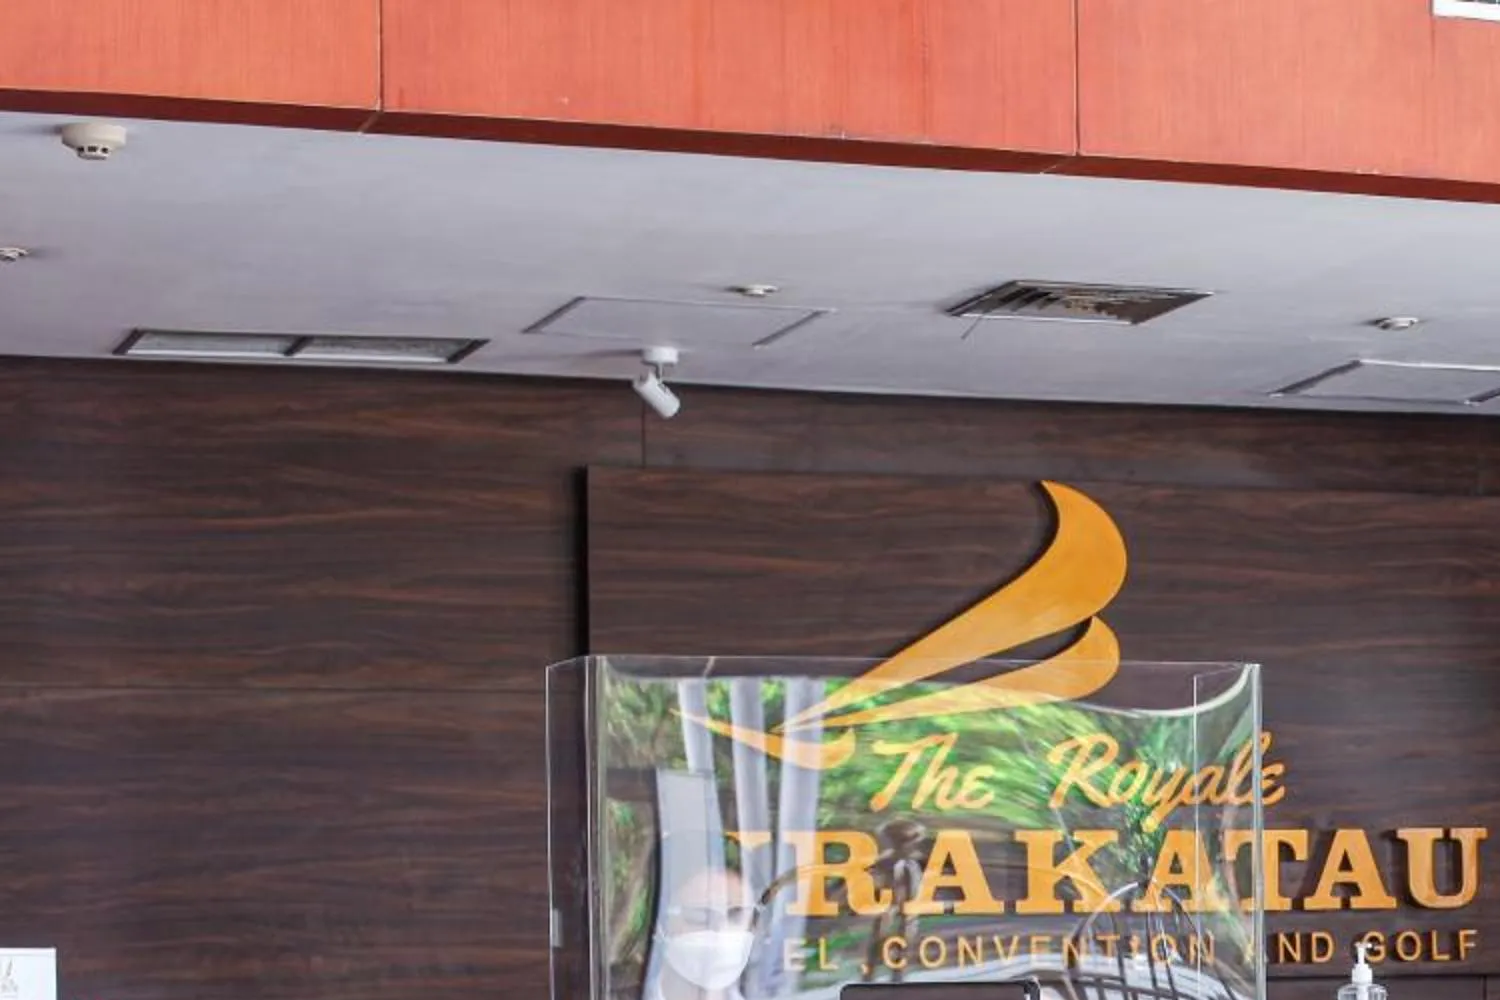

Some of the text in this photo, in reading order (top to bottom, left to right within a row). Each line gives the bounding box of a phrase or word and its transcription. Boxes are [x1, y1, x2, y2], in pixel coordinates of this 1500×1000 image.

[869, 731, 1287, 833] The Royale
[724, 826, 1488, 916] RAKATAU
[1266, 930, 1336, 963] ND
[1360, 928, 1478, 963] GOLF
